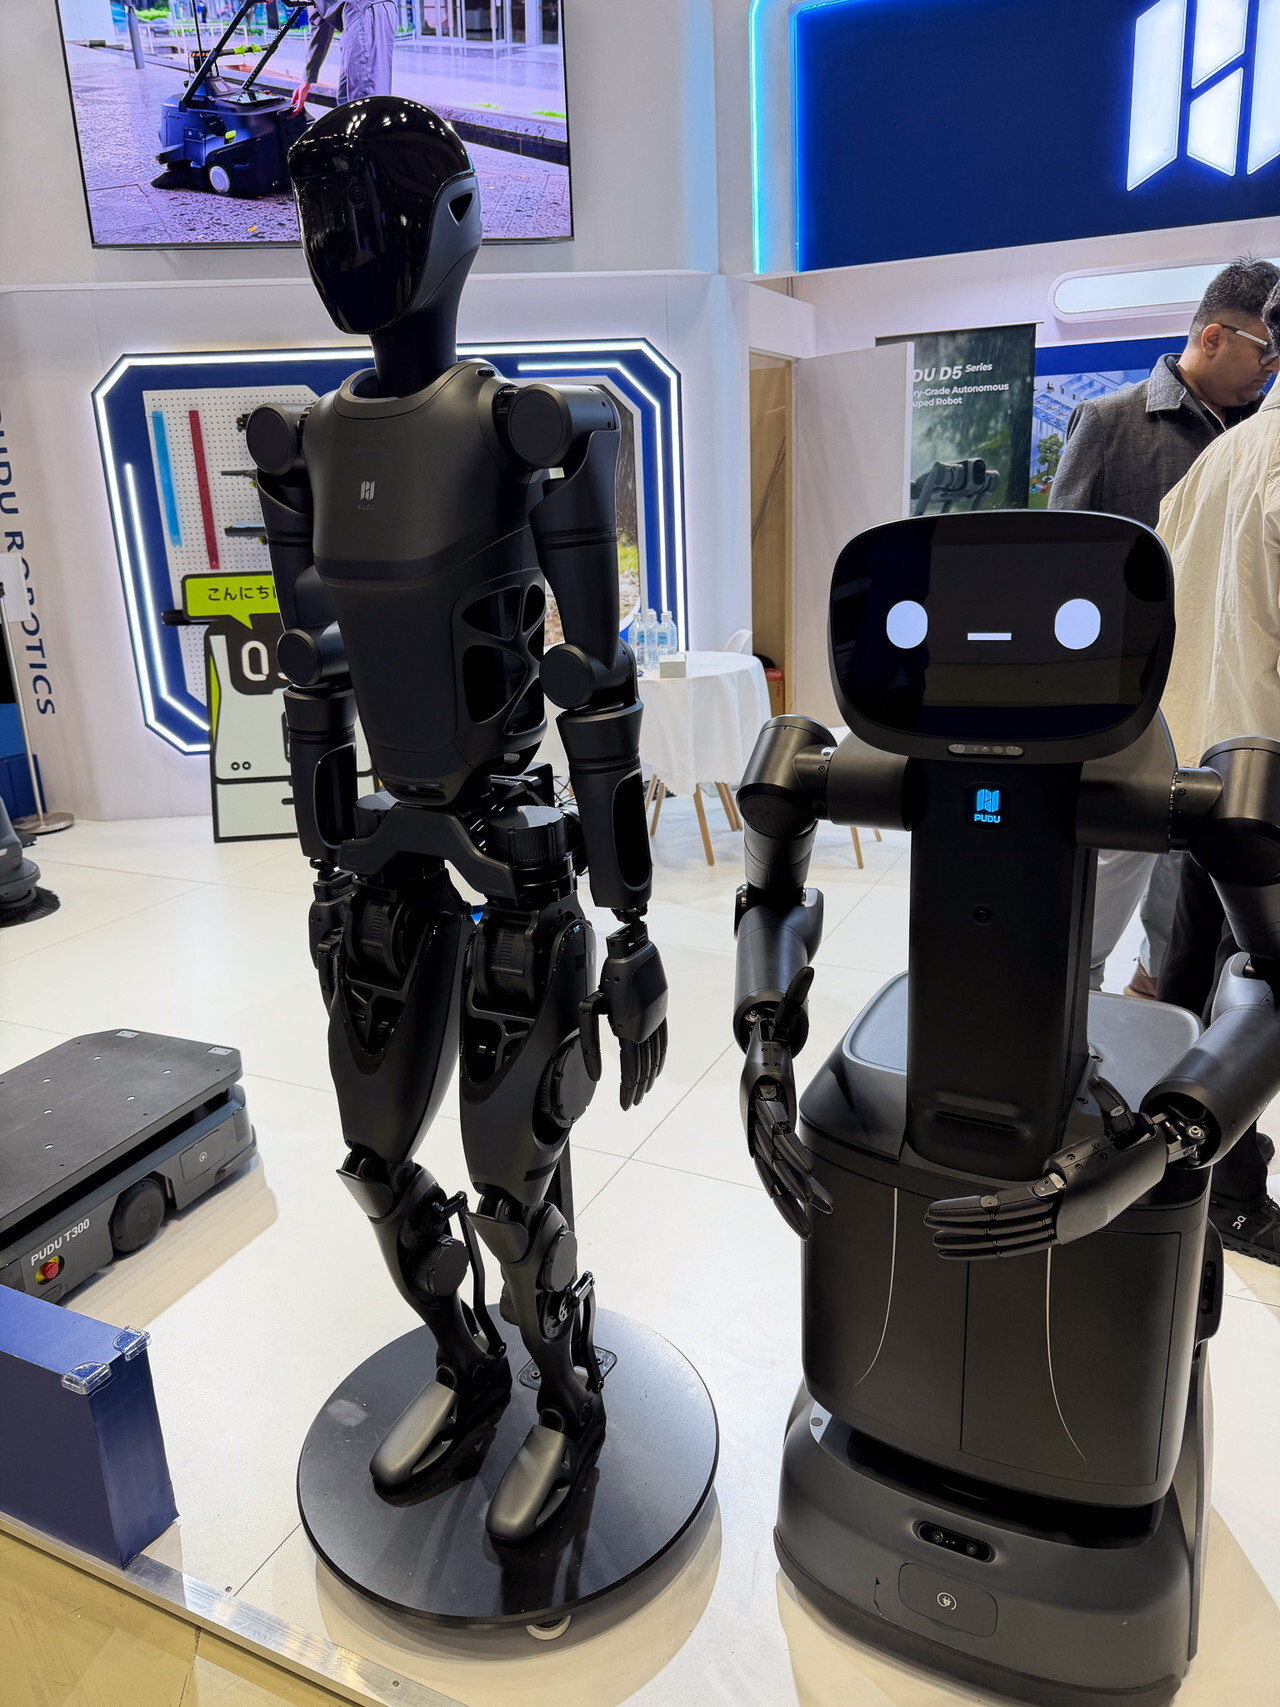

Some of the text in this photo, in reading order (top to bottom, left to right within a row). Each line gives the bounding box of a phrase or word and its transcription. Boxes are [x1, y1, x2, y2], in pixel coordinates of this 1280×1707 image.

[939, 365, 963, 381] D5
[965, 362, 993, 373] Series
[951, 383, 1010, 395] Autonomous
[936, 396, 963, 406] Robot
[974, 813, 1001, 824] PUDU
[30, 1218, 90, 1267] PUDU T300
